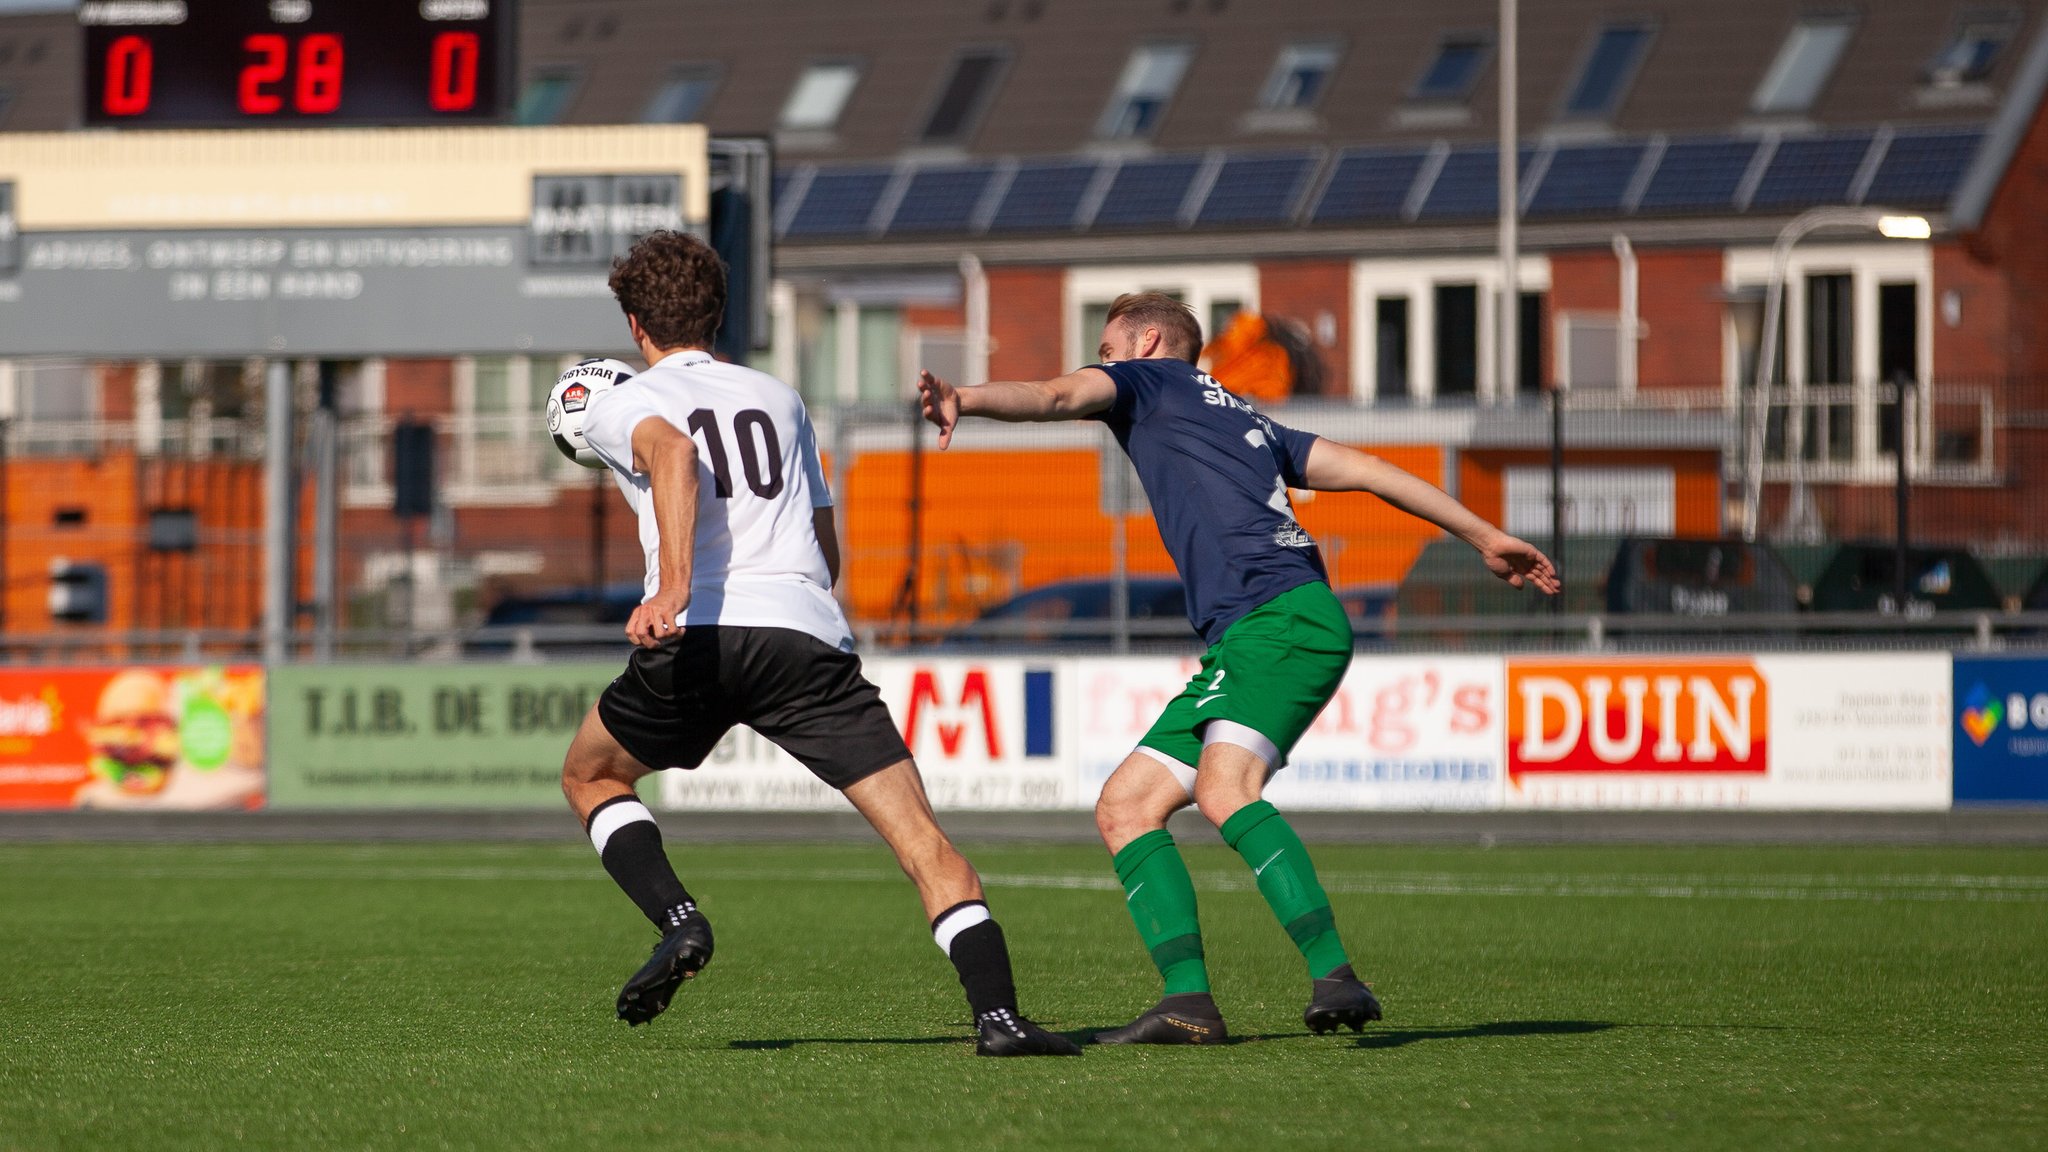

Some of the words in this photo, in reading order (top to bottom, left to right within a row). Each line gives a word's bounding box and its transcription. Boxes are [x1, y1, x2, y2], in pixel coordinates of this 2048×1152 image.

[104, 35, 152, 114] 0
[238, 33, 343, 113] 28
[430, 31, 479, 110] 0
[556, 367, 613, 384] RBYSTAR
[687, 408, 784, 500] 10
[1208, 670, 1225, 690] 2
[1518, 676, 1756, 763] DUIN
[1167, 1017, 1210, 1034] NEMESIS
